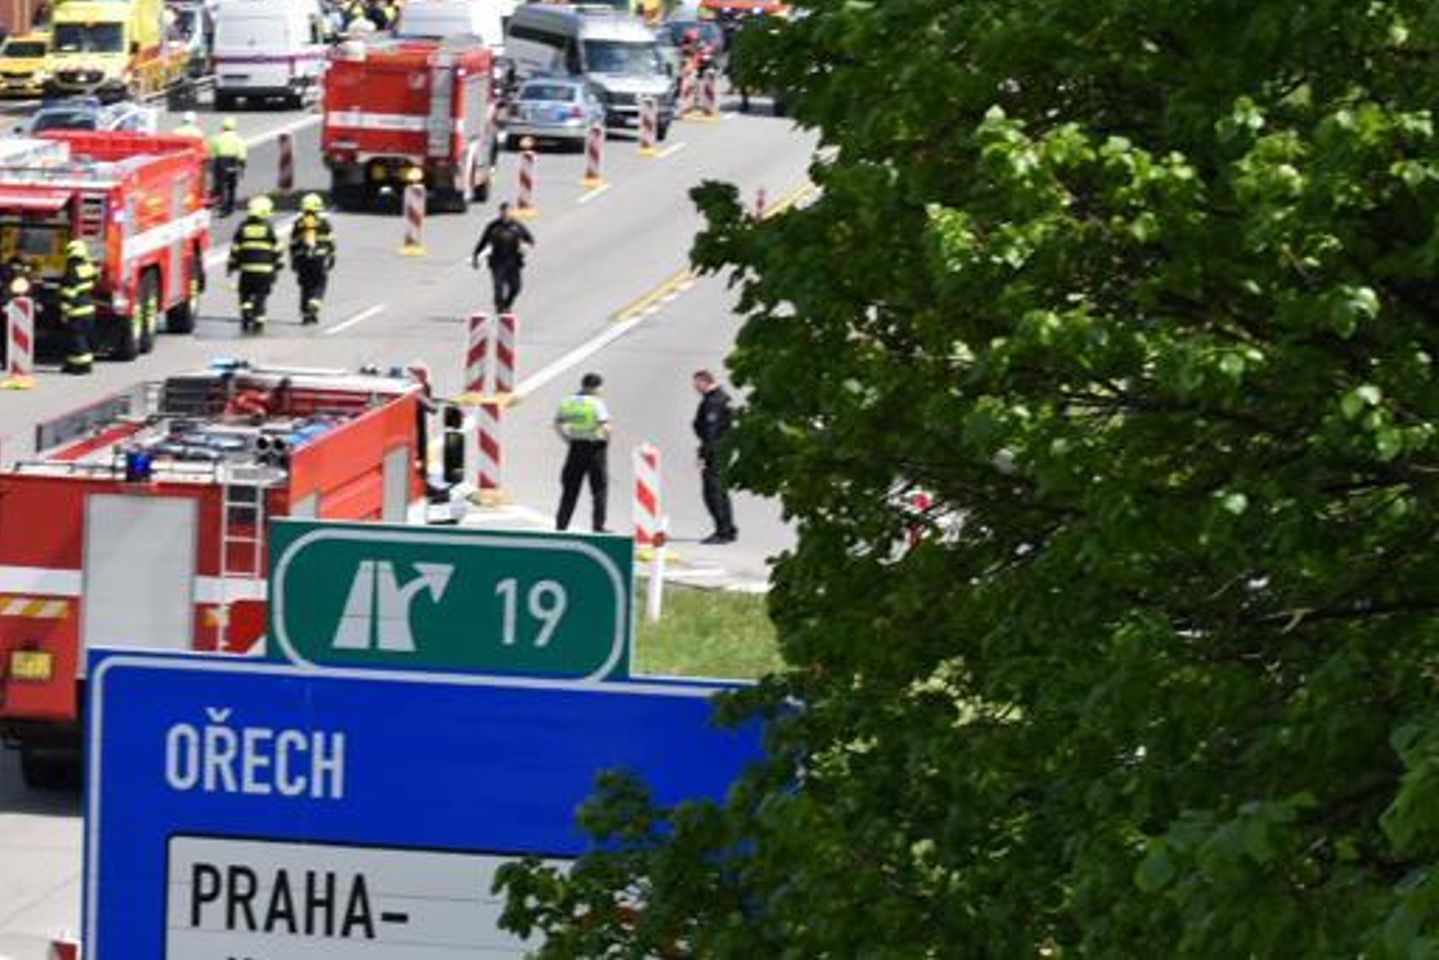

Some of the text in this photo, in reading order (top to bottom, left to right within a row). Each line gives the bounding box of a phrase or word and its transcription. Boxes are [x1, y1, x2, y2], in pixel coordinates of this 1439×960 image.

[495, 578, 567, 647] 19
[165, 707, 345, 800] OŘECH
[191, 862, 409, 939] PRAHA-
